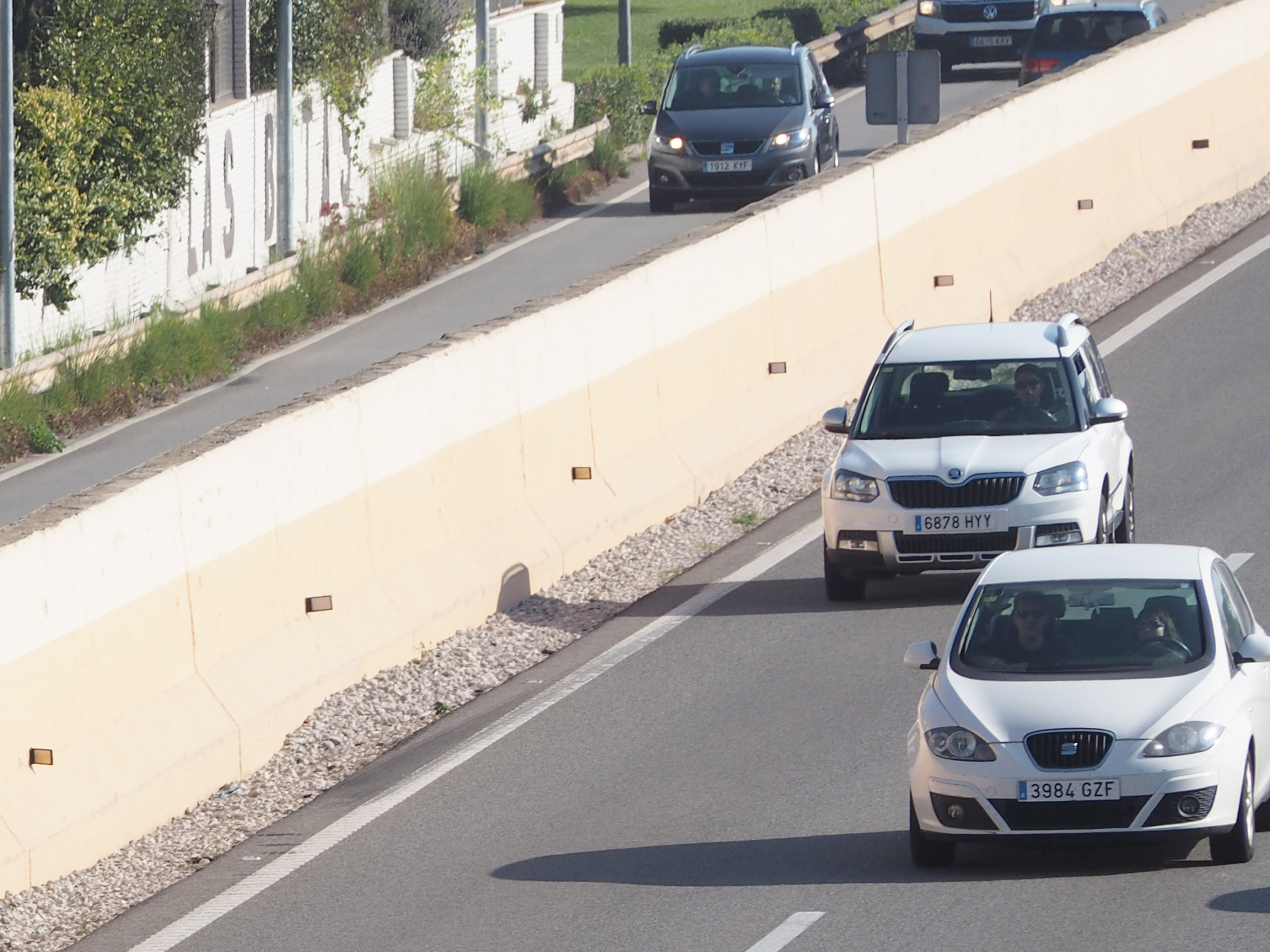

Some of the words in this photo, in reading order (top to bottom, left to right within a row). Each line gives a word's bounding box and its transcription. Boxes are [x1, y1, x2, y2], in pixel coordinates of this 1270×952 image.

[710, 161, 729, 171] 1912
[188, 129, 235, 277] LAS
[264, 95, 352, 242] BTAS
[924, 515, 960, 529] 6878
[965, 514, 991, 528] HYY
[1031, 782, 1075, 798] 3984
[1082, 781, 1114, 797] GZF
